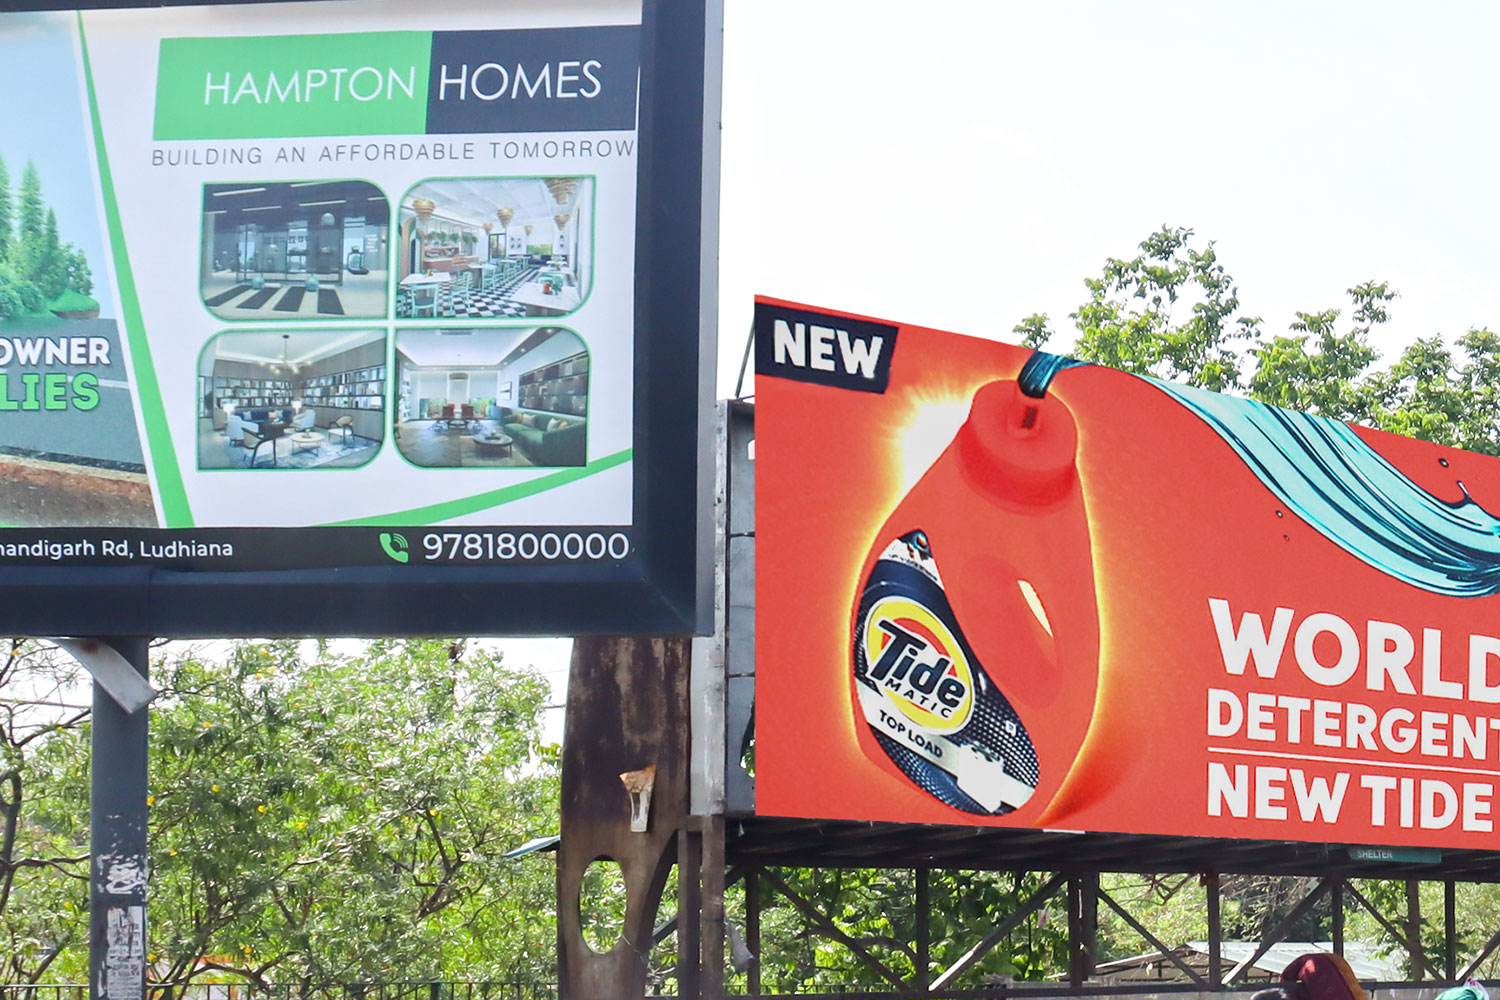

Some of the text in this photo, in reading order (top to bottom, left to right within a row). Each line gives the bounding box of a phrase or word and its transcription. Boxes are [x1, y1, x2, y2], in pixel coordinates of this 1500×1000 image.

[204, 60, 602, 105] HAMPTON HOMES
[152, 139, 634, 166] BUILDING AN AFFORDABLE TOMORROW
[773, 319, 884, 379] NEW
[102, 540, 134, 559] Rd,
[140, 540, 233, 558] Ludhiana
[423, 533, 629, 560] 9781800000
[870, 619, 965, 708] Tide
[885, 678, 952, 718] MATIC
[880, 709, 943, 758] TOP LOAD
[1207, 762, 1350, 824] NEW
[1361, 774, 1494, 832] TIDE
